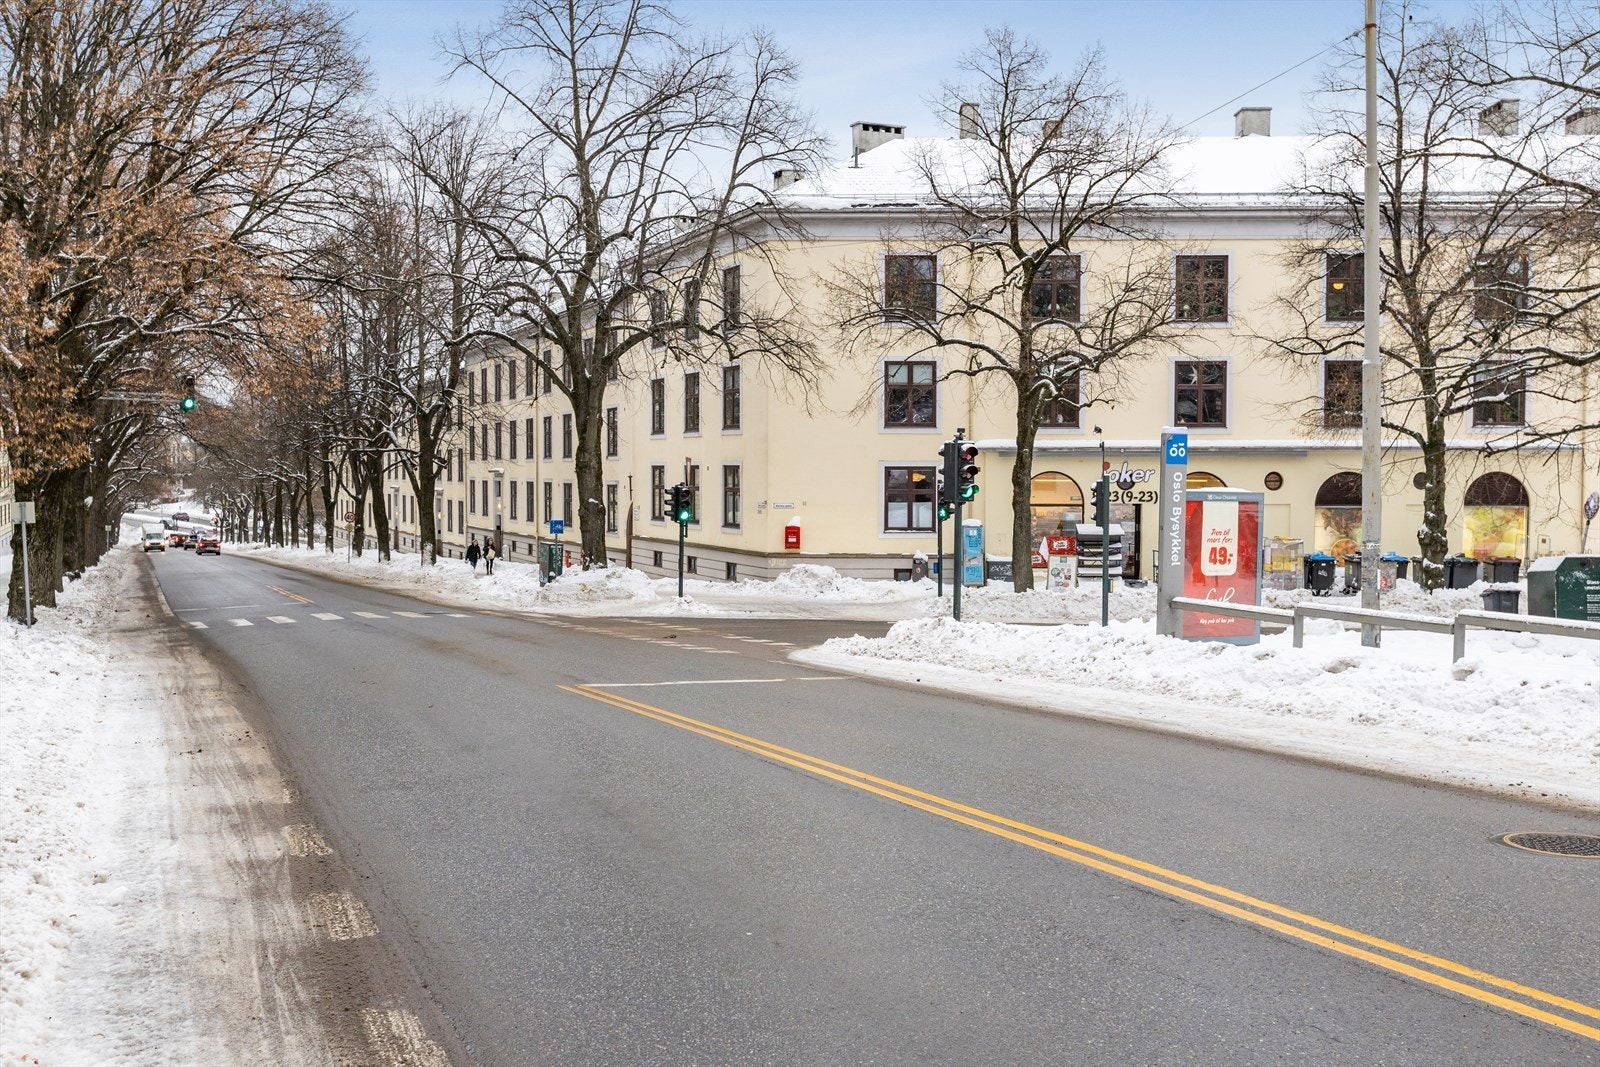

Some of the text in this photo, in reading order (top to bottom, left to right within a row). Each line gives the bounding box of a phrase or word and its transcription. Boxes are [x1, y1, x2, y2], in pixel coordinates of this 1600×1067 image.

[1121, 491, 1158, 504] (9-23)
[1170, 472, 1183, 566] Oslo Bysykkel
[1211, 528, 1231, 536] Tren til
